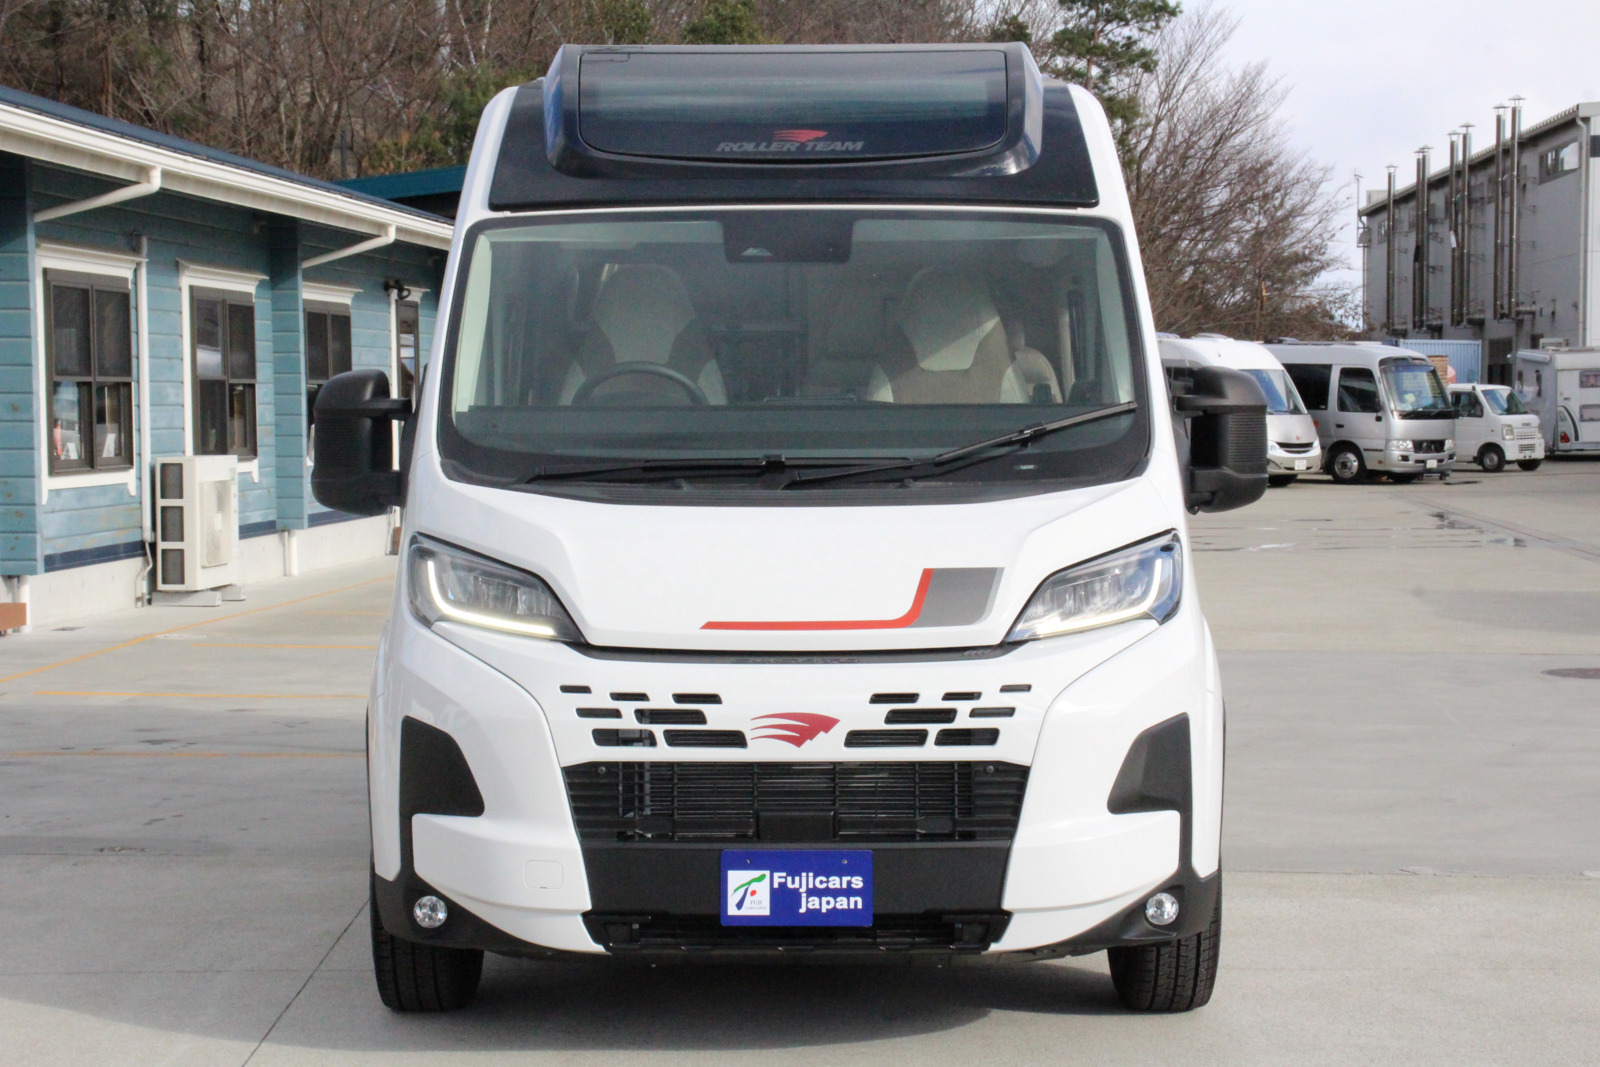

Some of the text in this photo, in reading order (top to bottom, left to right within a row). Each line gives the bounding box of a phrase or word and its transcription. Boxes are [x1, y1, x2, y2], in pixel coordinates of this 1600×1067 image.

[716, 141, 865, 152] ROLLER TEAM
[772, 872, 864, 893] Fujicars
[798, 893, 863, 914] japan
